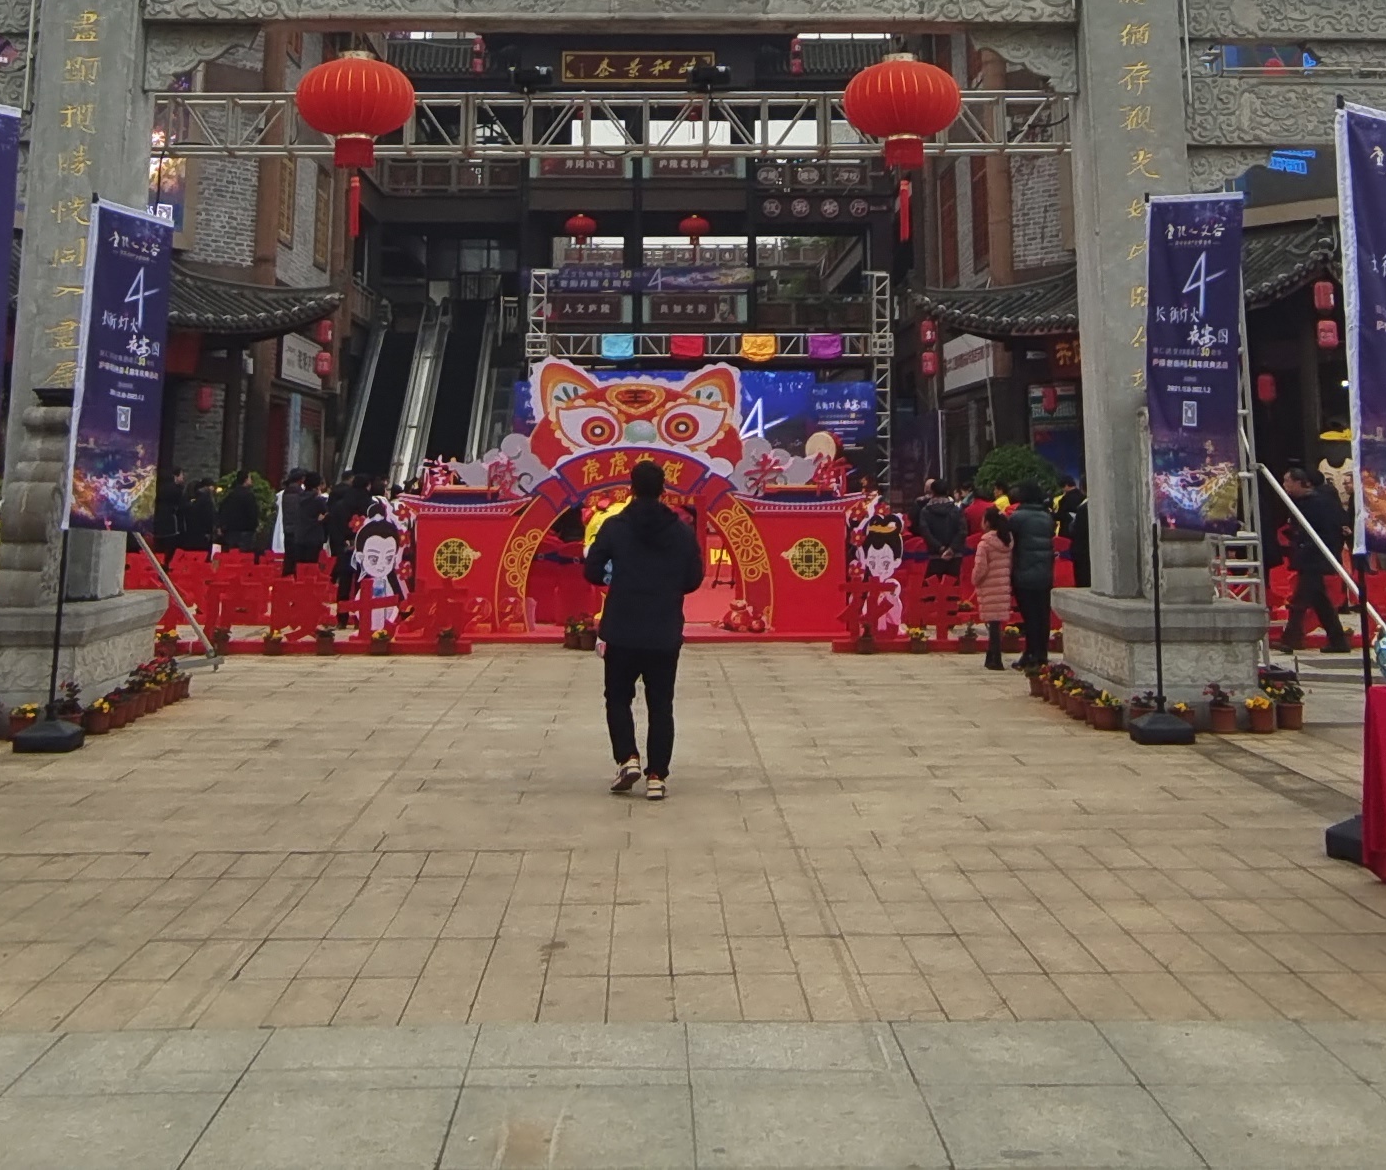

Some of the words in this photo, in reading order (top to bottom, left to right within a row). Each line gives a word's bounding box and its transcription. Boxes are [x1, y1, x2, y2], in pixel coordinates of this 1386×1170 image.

[124, 267, 160, 329] 4
[1182, 251, 1228, 318] 4
[1156, 306, 1200, 323] 长街灯火
[1187, 323, 1229, 348] 夜宴图
